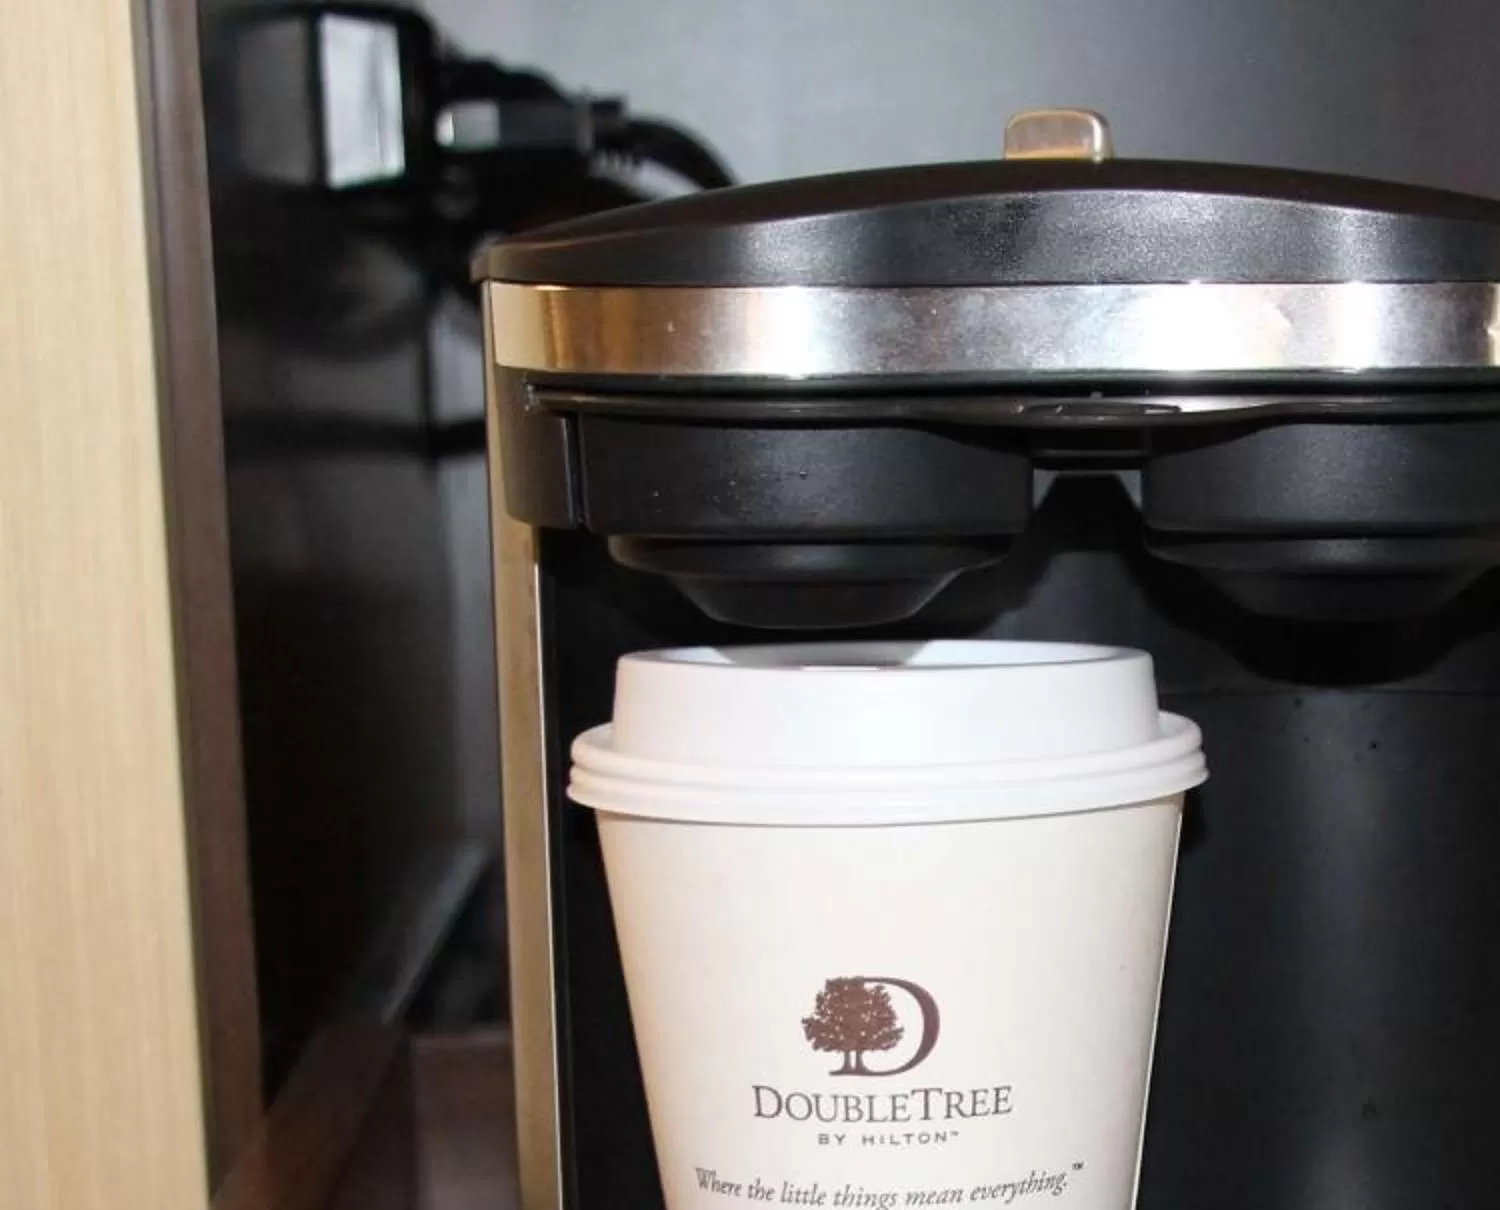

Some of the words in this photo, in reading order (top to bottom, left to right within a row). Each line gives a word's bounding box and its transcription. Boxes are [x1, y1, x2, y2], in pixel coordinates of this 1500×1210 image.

[817, 1133, 847, 1146] BY
[695, 1166, 742, 1197] Where
[747, 1176, 775, 1201] the
[780, 1180, 826, 1206] little
[904, 1187, 964, 1206] mean
